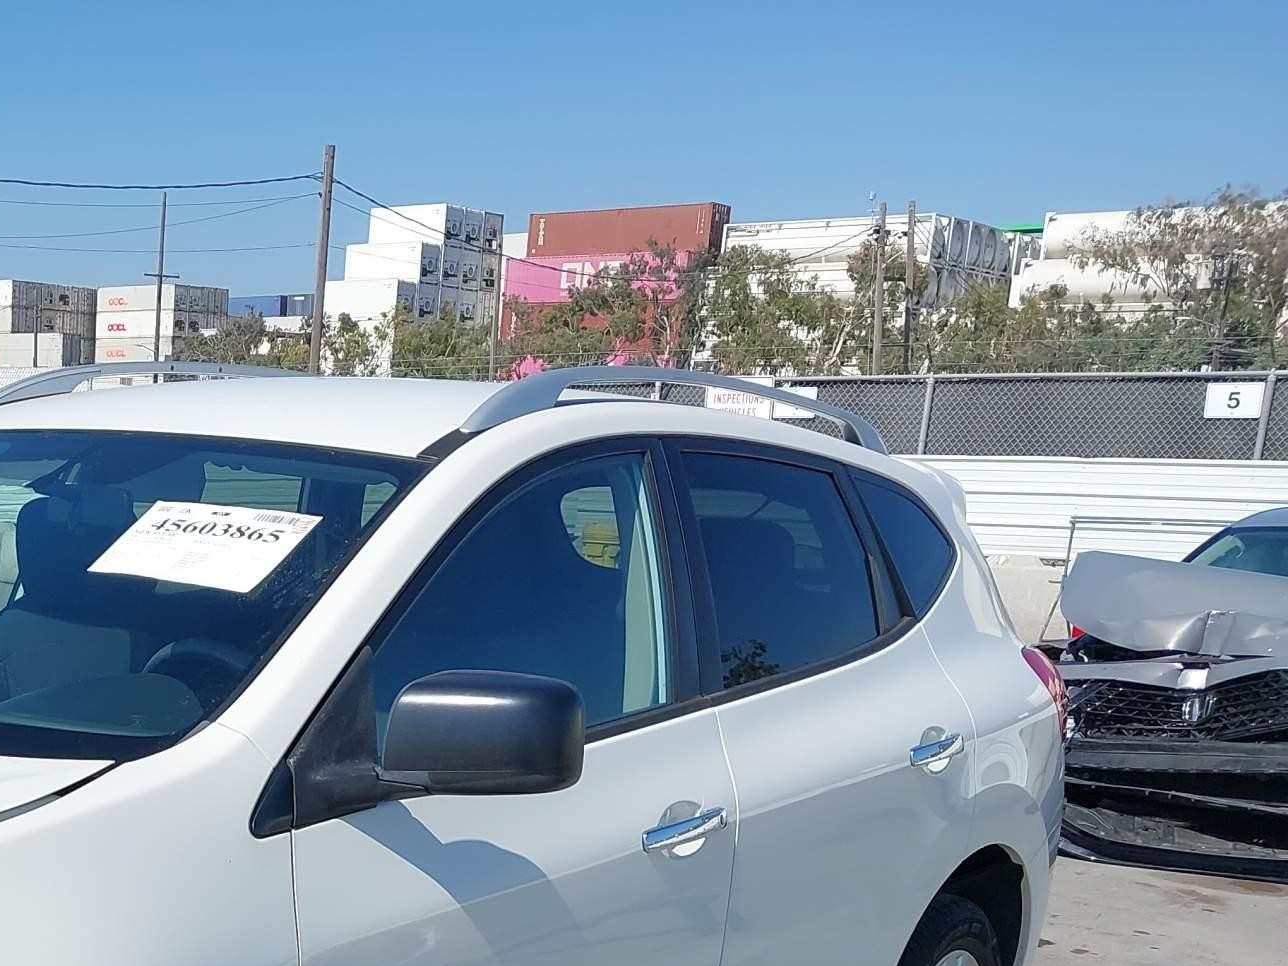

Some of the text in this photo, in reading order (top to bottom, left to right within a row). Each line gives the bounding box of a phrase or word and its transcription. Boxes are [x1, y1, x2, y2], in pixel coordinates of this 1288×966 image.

[107, 323, 127, 332] OOCL
[1227, 392, 1241, 409] 5
[151, 517, 286, 544] 45603865
